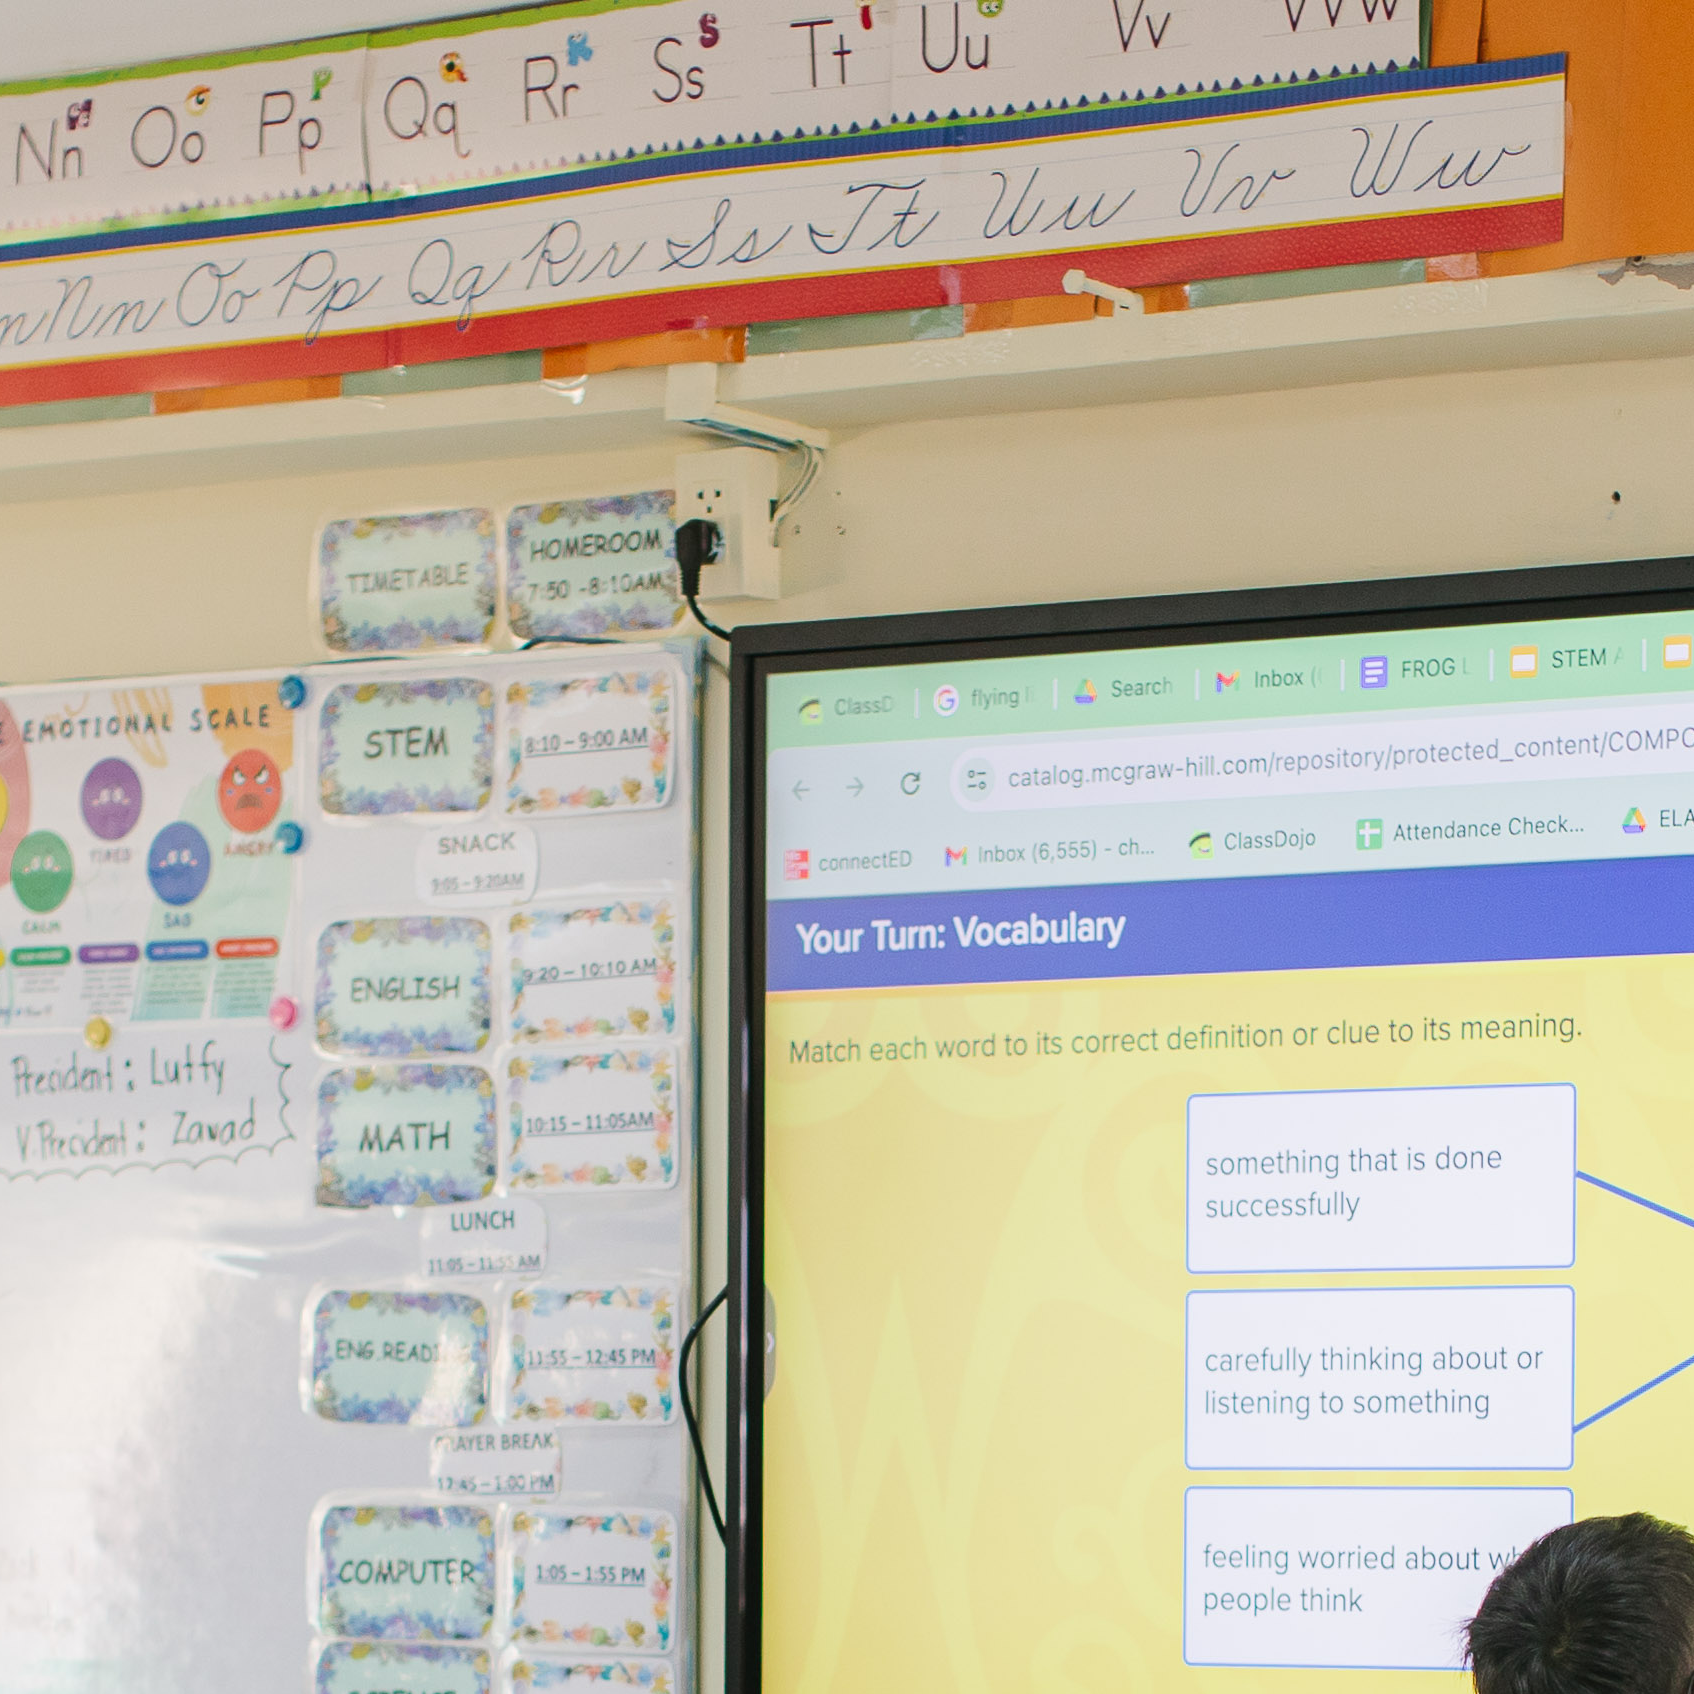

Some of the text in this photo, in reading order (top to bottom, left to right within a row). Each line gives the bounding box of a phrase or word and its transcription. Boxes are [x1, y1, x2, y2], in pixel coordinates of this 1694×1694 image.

[15, 124, 84, 187] Nn
[131, 105, 203, 167] Oo
[259, 90, 321, 174] Pp
[384, 76, 470, 158] Qq
[524, 54, 581, 122] Rr
[653, 37, 704, 103] Ss
[791, 20, 853, 89] Tt
[529, 529, 662, 562] HOMEROOM
[345, 563, 468, 594] TIMETABLE
[528, 580, 569, 600] 7:50
[1402, 660, 1455, 678] FROG
[1552, 648, 1606, 669] STEM
[1111, 677, 1172, 697] Search
[1255, 668, 1303, 689] Inbox
[971, 687, 1019, 709] flying
[23, 715, 171, 743] EMOTIONAL
[190, 705, 270, 731] SCALE
[363, 727, 449, 759] STEM
[525, 728, 649, 753] 8:10 9:00 AM
[1224, 830, 1316, 852] ClassDojo
[1394, 816, 1584, 843] Attendance Check...
[438, 831, 516, 855] SNACK
[978, 843, 1026, 864] Inbox
[819, 850, 912, 873] connectED
[797, 912, 1126, 956] Your Turn: Vocabulary
[523, 958, 657, 983] 9:20 10:10 AM
[350, 976, 460, 1001] ENGLISH
[790, 1012, 1583, 1066] Match each word to its correct definition or clue to its meaning.
[359, 1121, 450, 1152] MATH
[526, 1117, 567, 1134] 10:15
[1206, 1144, 1502, 1178] something that is done
[1206, 1191, 1360, 1221] successfully
[451, 1211, 515, 1231] LUNCH
[528, 1348, 656, 1366] 11:55 12:45 PM
[1205, 1345, 1543, 1377] carefully thinking about or
[1205, 1390, 1489, 1420] listening to something
[501, 1433, 553, 1450] BREAK
[1204, 1544, 1479, 1574] feeling worried about
[338, 1559, 476, 1585] COMPUTER
[536, 1566, 645, 1582] 1:05 1:55 PM
[1204, 1587, 1363, 1618] people think
